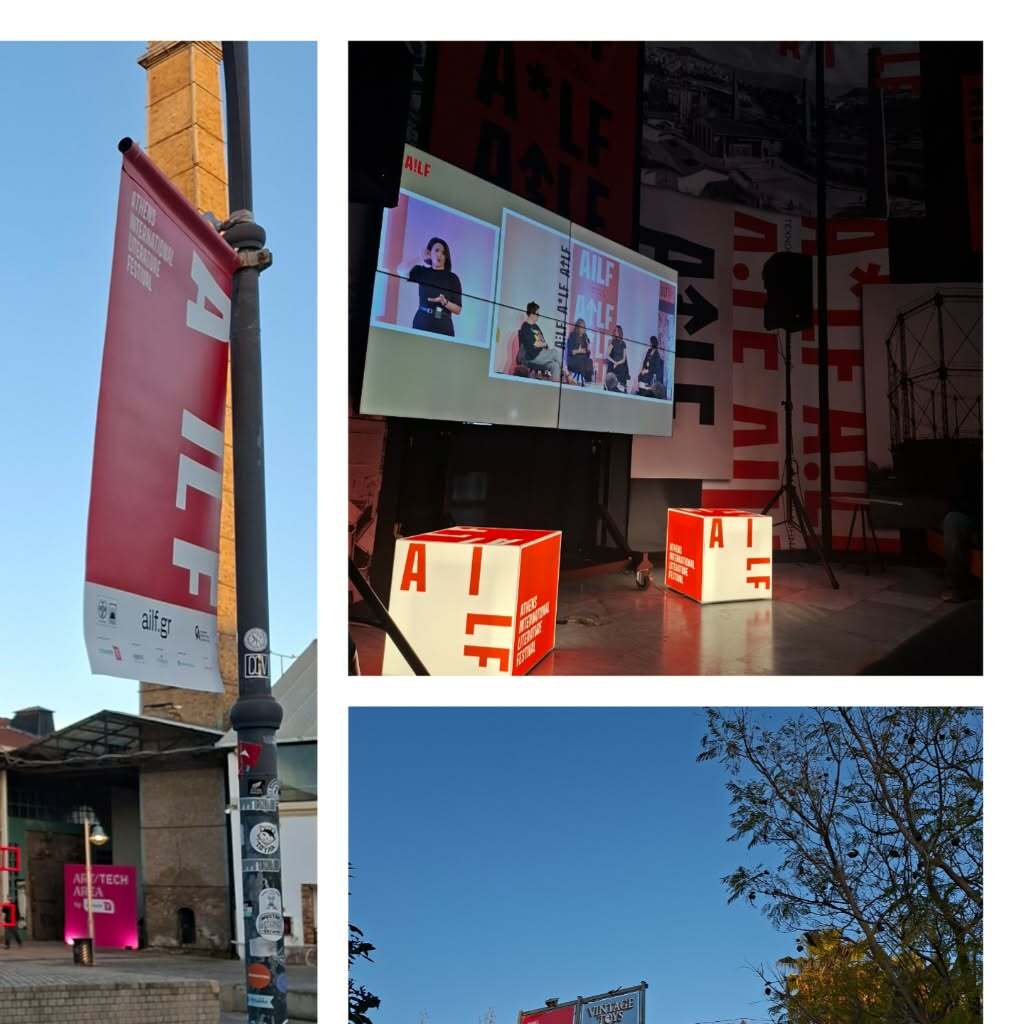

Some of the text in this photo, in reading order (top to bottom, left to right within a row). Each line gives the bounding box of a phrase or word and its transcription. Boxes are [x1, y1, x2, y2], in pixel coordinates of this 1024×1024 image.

[519, 601, 550, 634] INTERNATIONAL
[520, 595, 538, 618] ATHENS
[141, 609, 173, 639] ailf.gr
[518, 620, 543, 651] LITERATURE
[516, 641, 536, 668] FESTIVAL
[72, 873, 129, 886] AR/TECH
[588, 998, 633, 1019] VINTAGE
